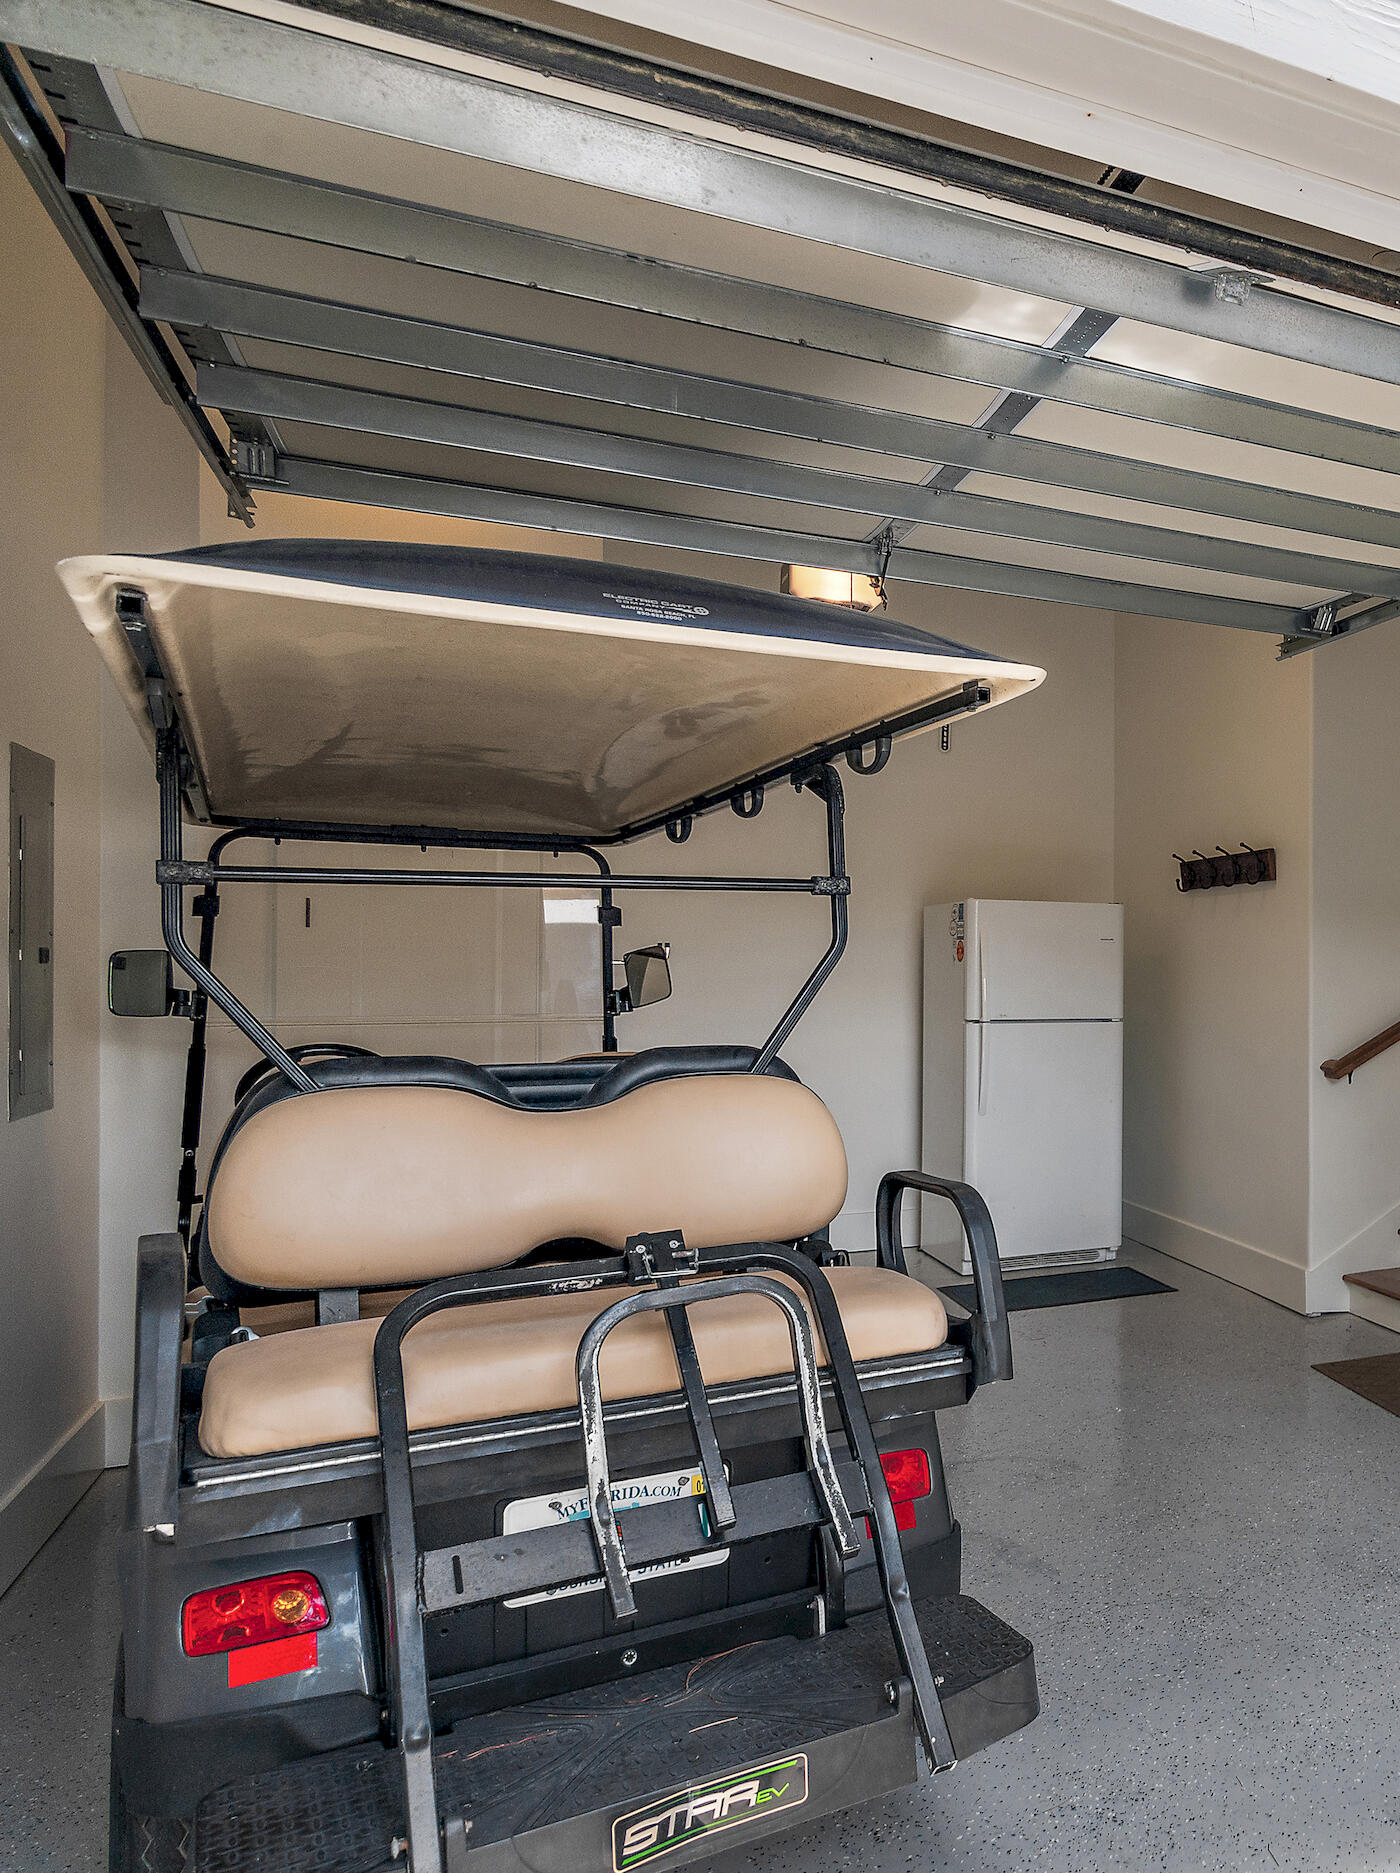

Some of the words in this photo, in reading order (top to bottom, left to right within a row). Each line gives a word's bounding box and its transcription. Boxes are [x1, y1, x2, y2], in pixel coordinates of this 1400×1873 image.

[602, 592, 659, 605] ELECTRIC
[660, 601, 693, 609] CART
[615, 599, 665, 609] COMPANY
[556, 1484, 682, 1520] MYFRIDA.COM
[622, 1779, 761, 1856] STAR
[756, 1782, 790, 1804] EV
